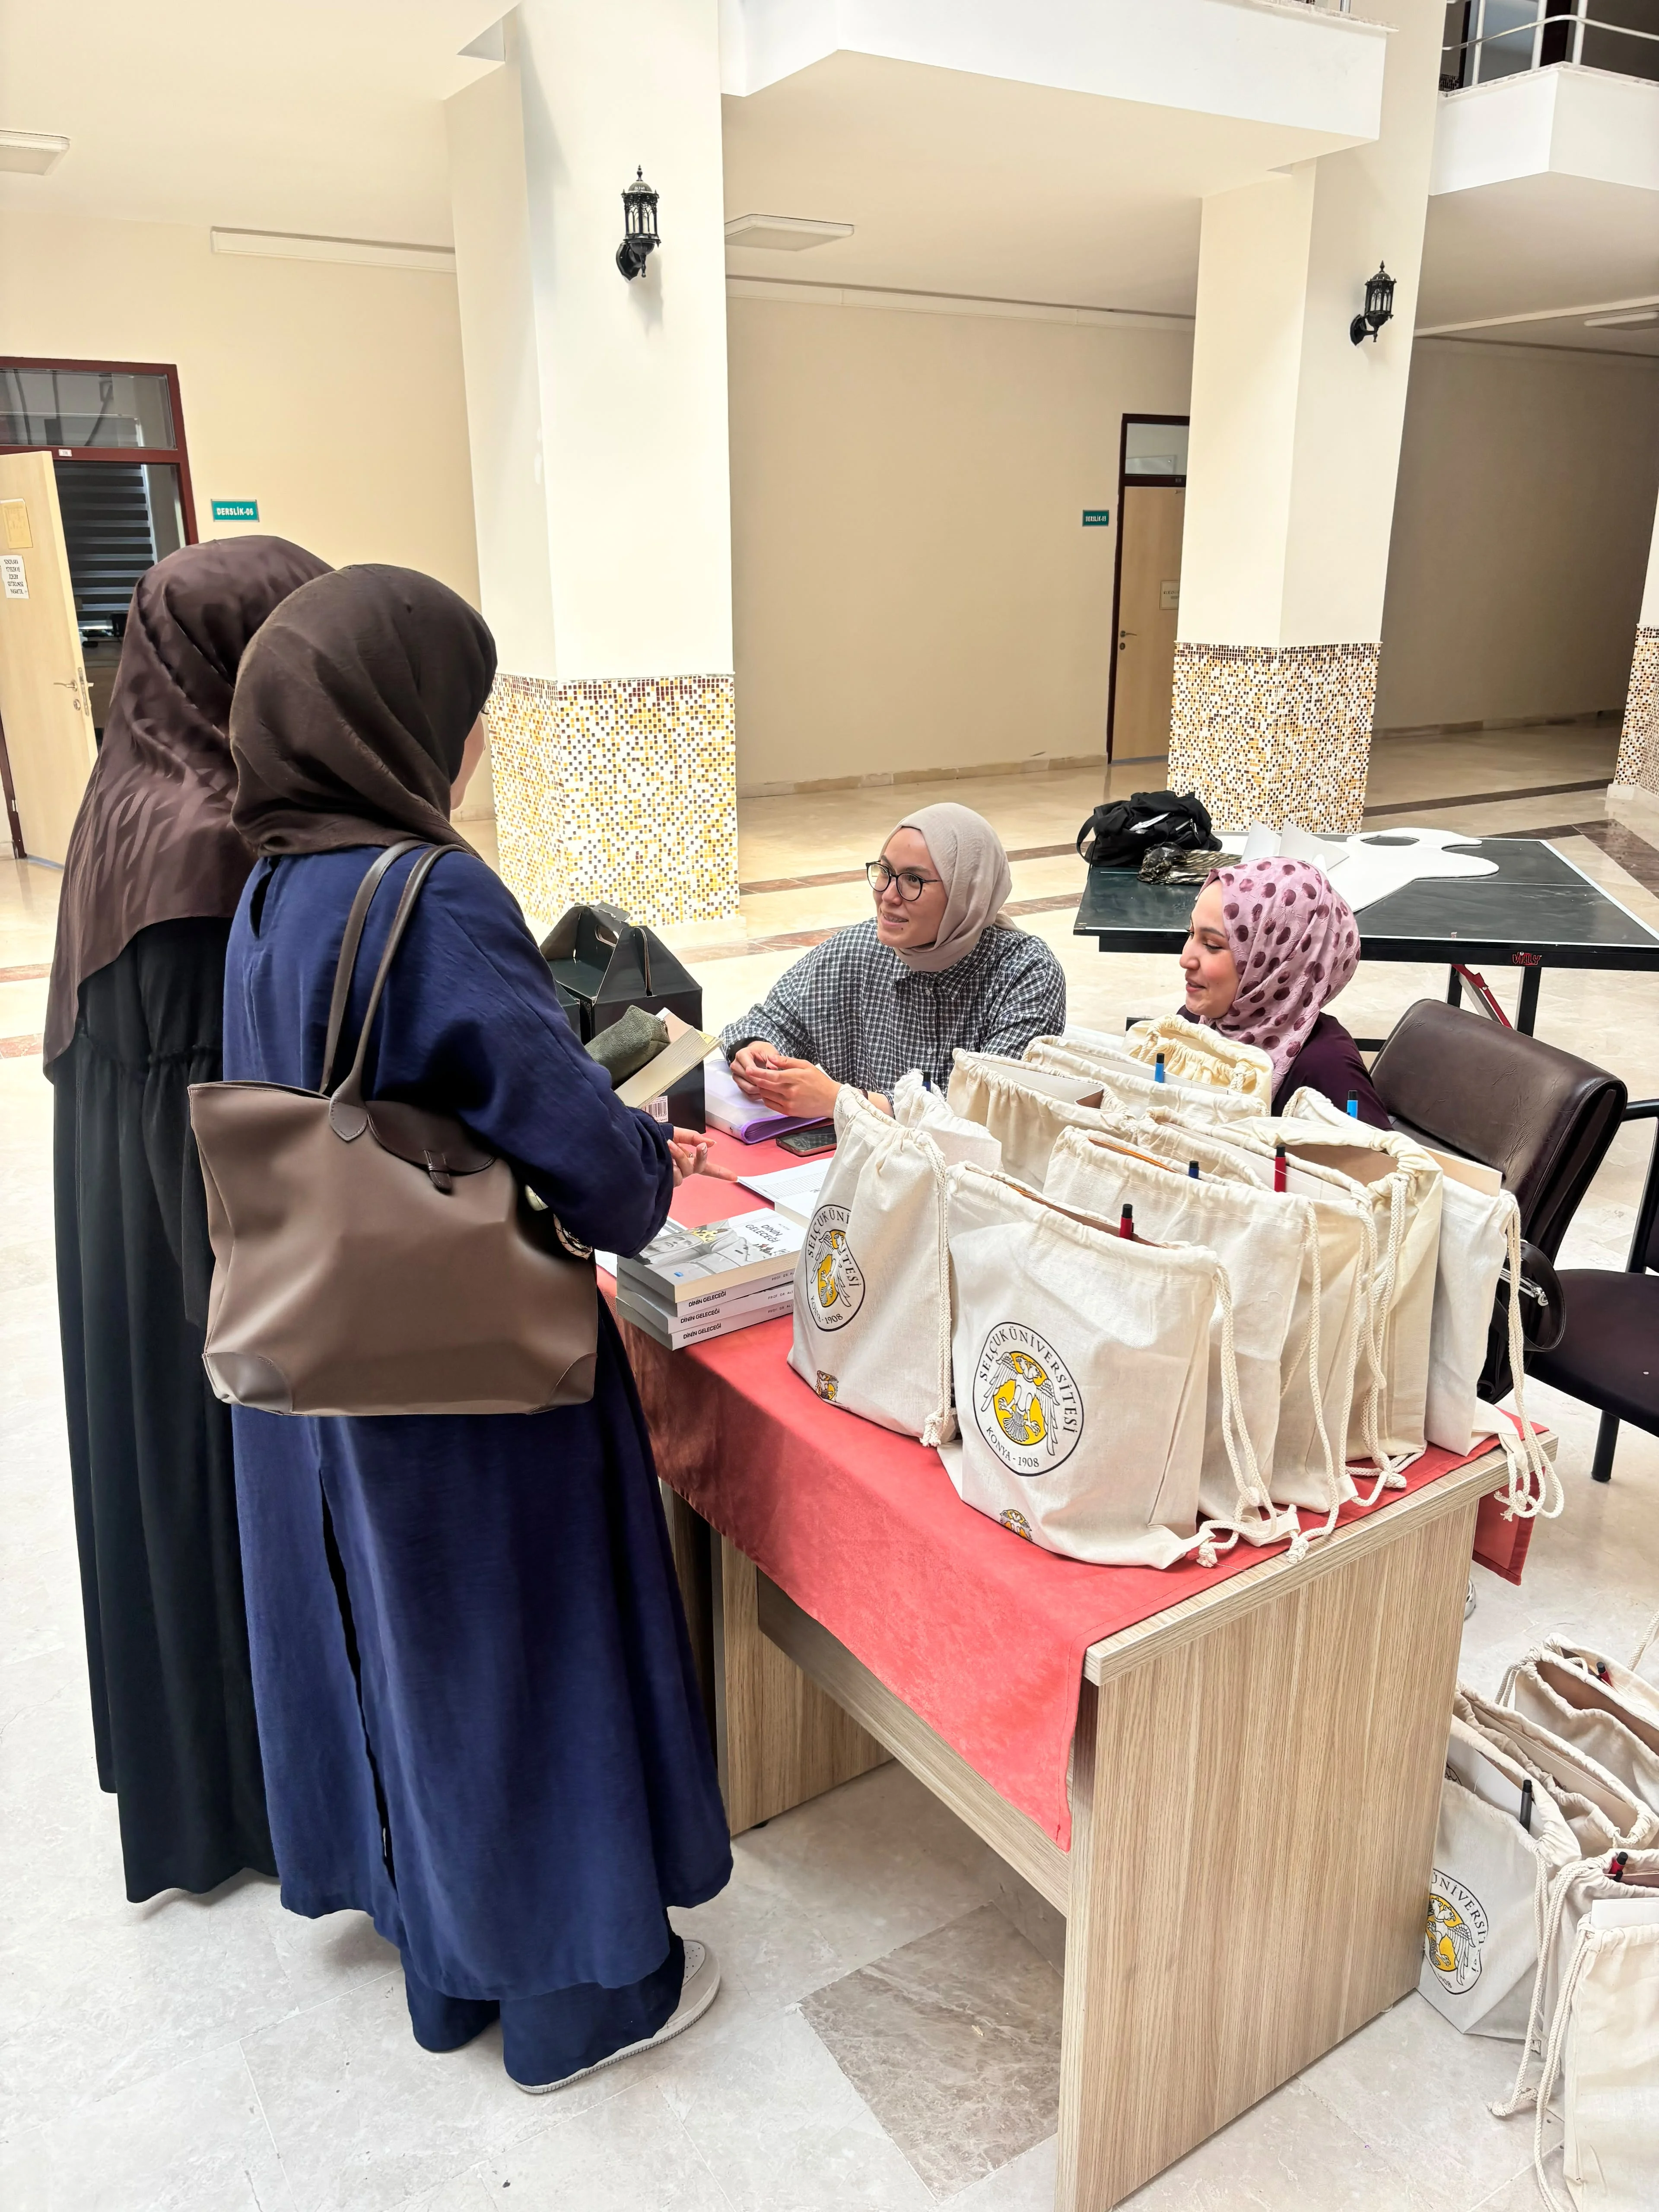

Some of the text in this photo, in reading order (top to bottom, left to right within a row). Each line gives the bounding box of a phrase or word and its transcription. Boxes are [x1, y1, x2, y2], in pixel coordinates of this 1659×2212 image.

[745, 1224, 781, 1243] GELECEĞİ
[761, 1224, 783, 1236] DİNİN
[807, 1211, 829, 1258] SELÇUK
[689, 1290, 726, 1307] DİNİN GELECEĞİ
[696, 1308, 720, 1319] GELECEĞİ
[825, 1314, 843, 1324] 1908
[683, 1322, 721, 1339] DİNİN GELECEĞİ
[980, 1326, 1078, 1433] SELÇUK ÜNİVERSİTESİ
[986, 1427, 1011, 1461] KONYA
[1018, 1457, 1039, 1467] 1908
